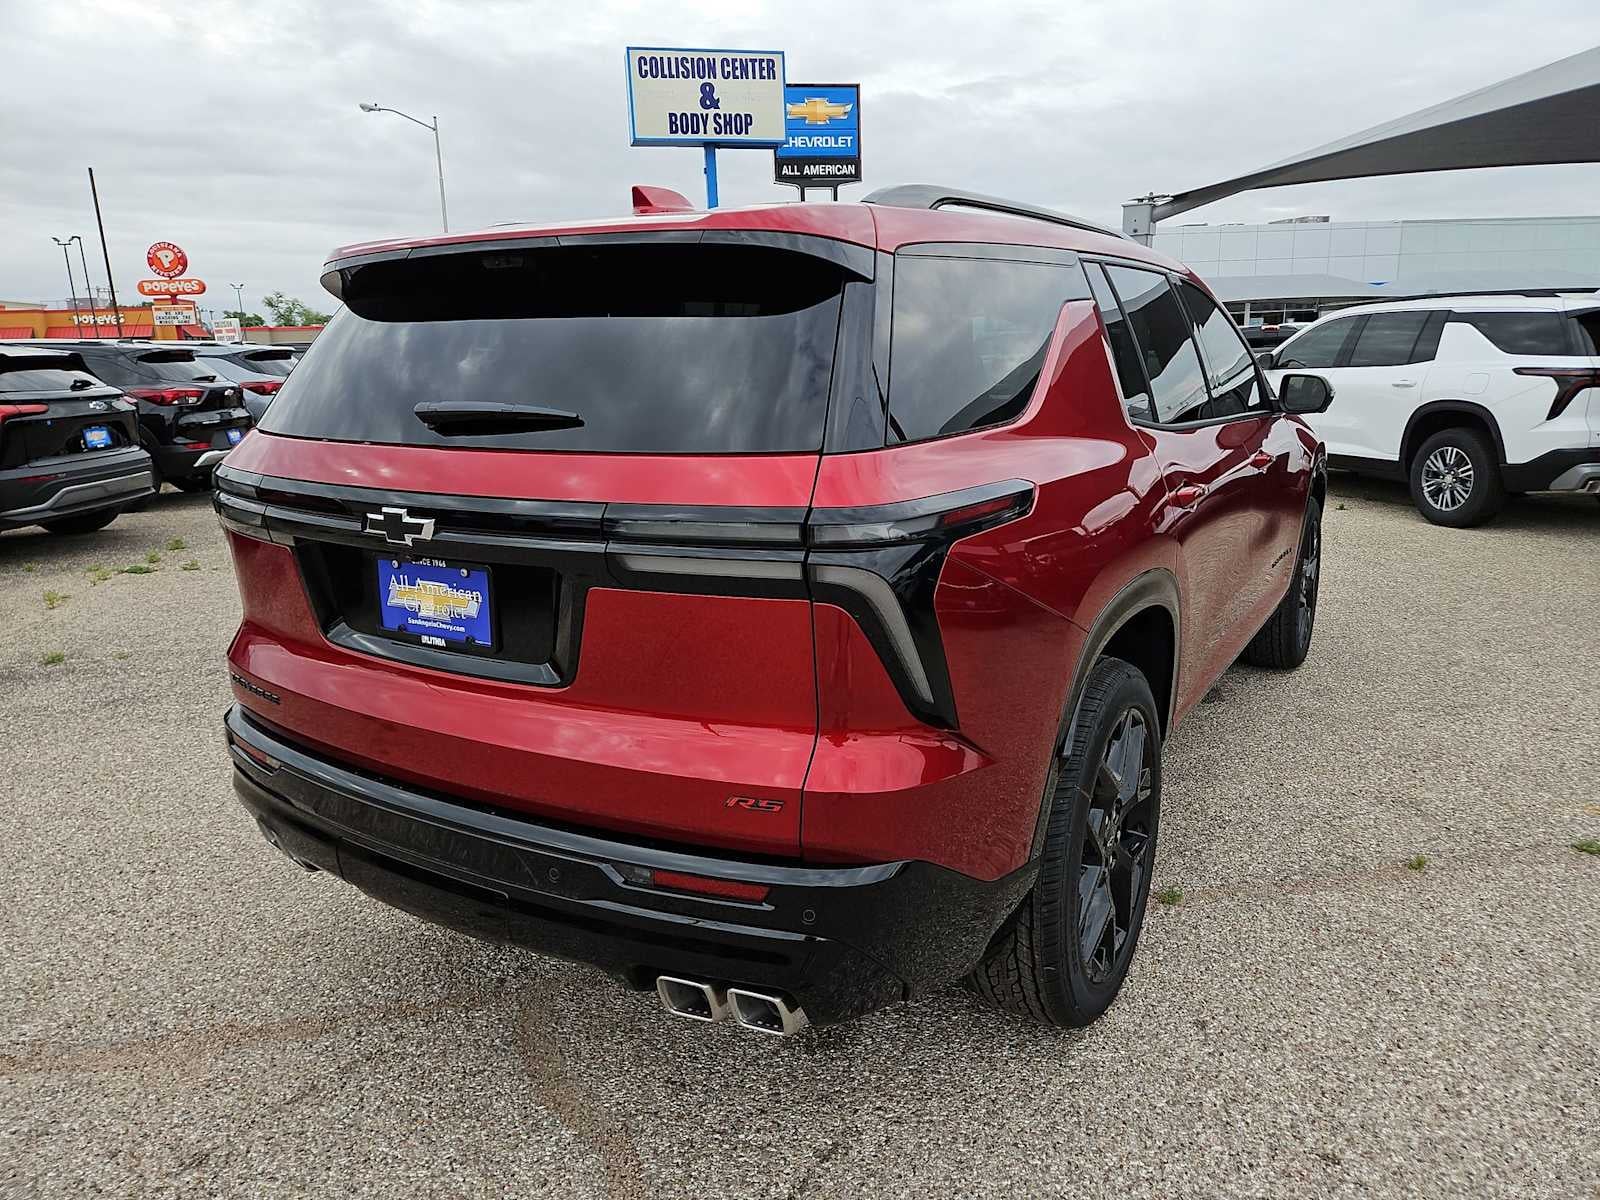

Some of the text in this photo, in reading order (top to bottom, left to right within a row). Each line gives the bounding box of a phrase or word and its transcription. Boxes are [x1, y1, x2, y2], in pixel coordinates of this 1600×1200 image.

[637, 55, 777, 80] COLLISION CENTER
[699, 81, 721, 110] &
[668, 112, 754, 136] BODY SHOP
[781, 164, 856, 176] ALL AMERICAN
[388, 574, 483, 602] All American
[723, 795, 785, 812] RS
